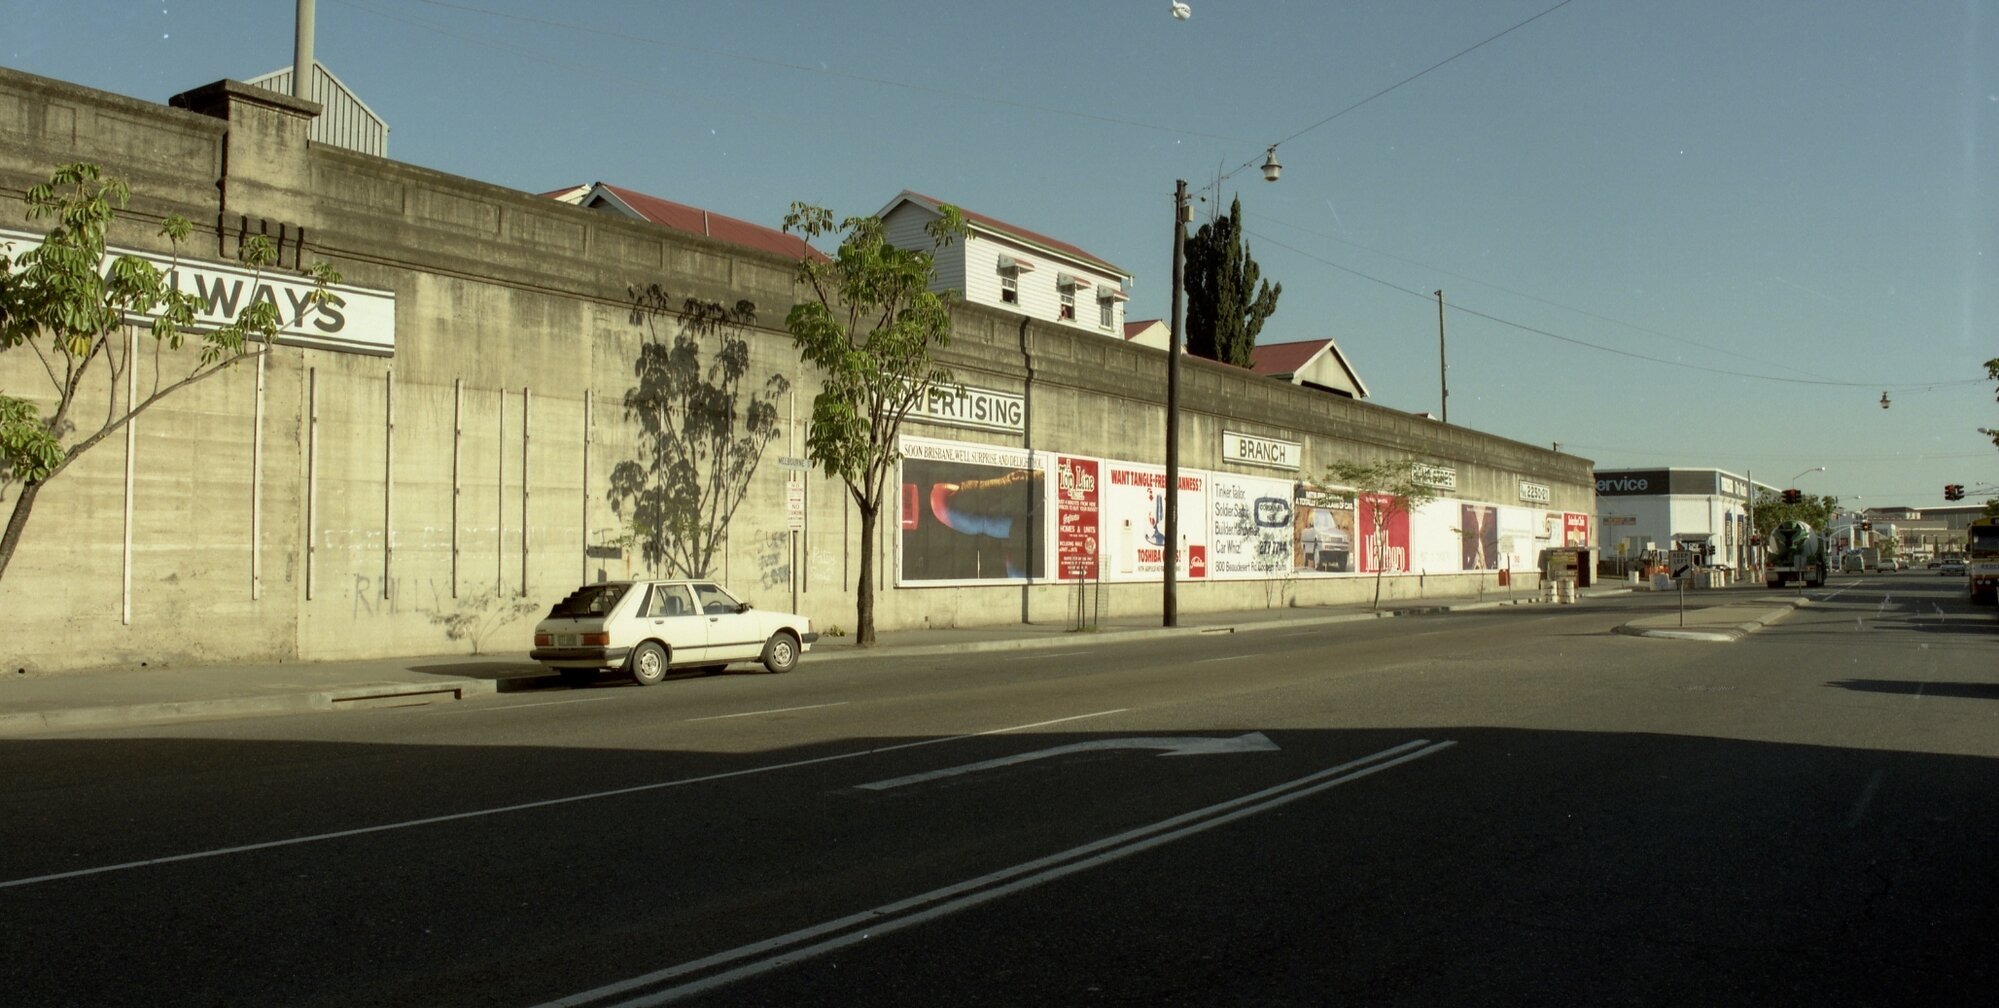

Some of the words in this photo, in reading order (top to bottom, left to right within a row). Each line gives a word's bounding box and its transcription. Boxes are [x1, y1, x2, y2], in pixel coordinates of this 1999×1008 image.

[886, 381, 1021, 425] VERTISING
[904, 445, 923, 457] SOON
[971, 452, 997, 464] SURPRISE
[999, 454, 1009, 465] AND
[1240, 439, 1286, 463] BRANCH
[1111, 469, 1130, 485] WANT
[1596, 476, 1648, 491] ervice
[1216, 539, 1226, 554] Car
[1365, 530, 1405, 571] Marlboro
[1137, 549, 1161, 563] TOSHIBA
